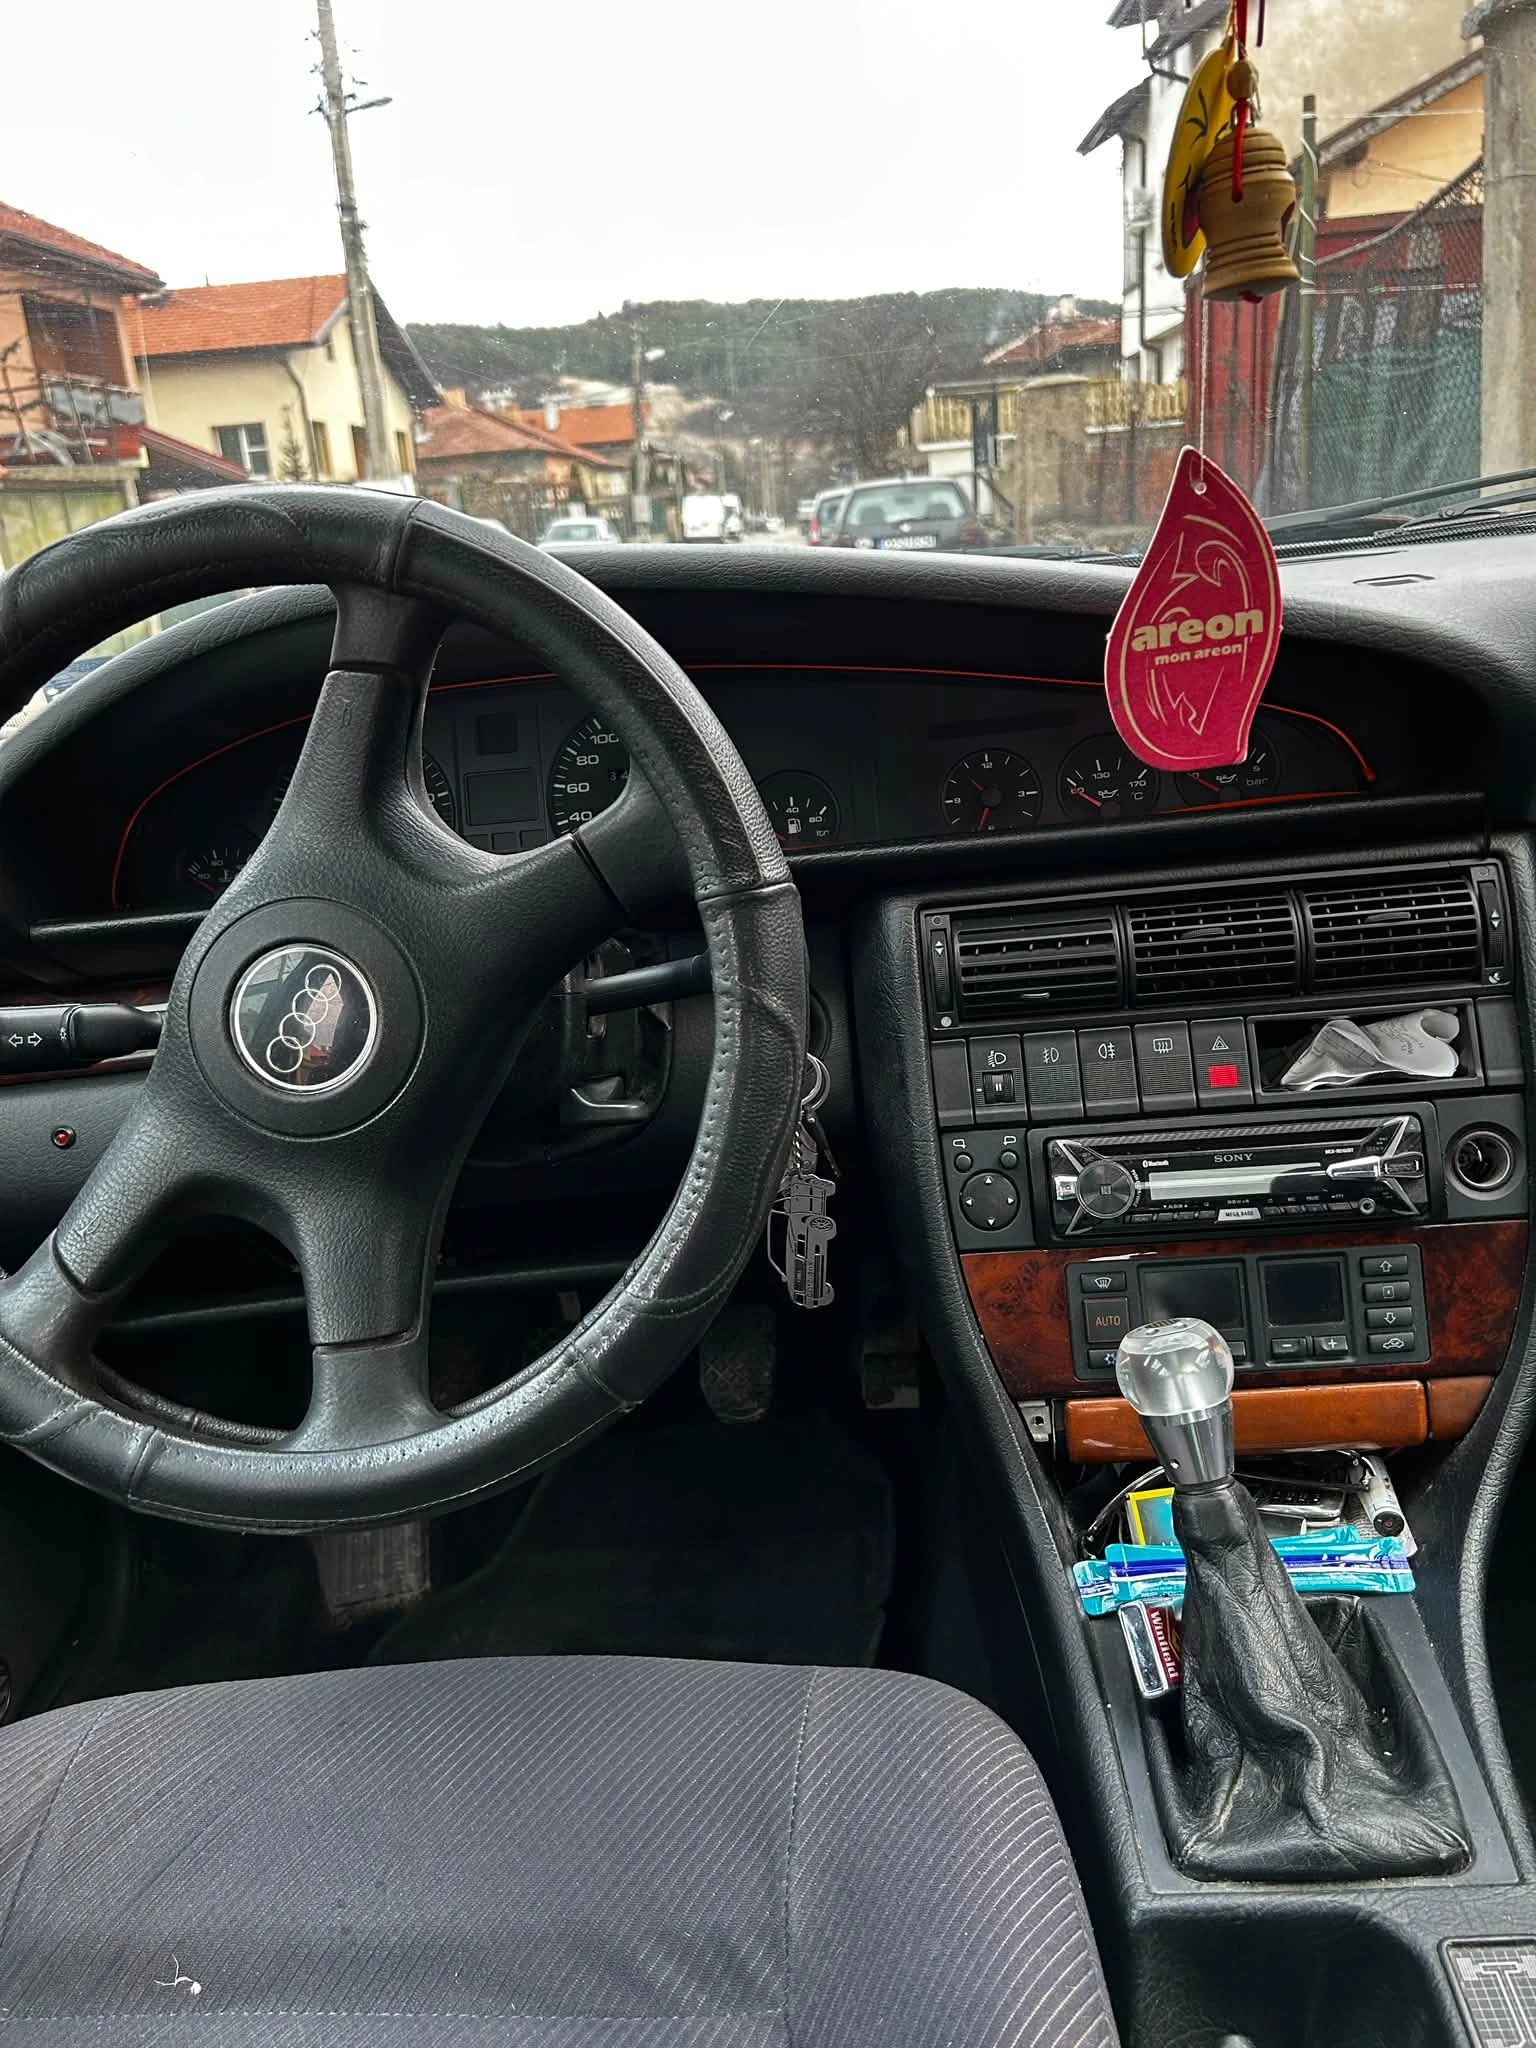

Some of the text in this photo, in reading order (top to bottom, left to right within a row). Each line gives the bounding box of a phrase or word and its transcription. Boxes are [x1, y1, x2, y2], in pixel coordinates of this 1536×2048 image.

[1131, 609, 1263, 652] areon
[1154, 643, 1243, 666] mon areon
[590, 733, 619, 744] 100
[576, 755, 599, 766] 80
[1092, 771, 1111, 780] 130
[567, 782, 590, 793] 60
[1129, 779, 1147, 788] 170
[569, 811, 593, 821] 40
[1213, 1152, 1254, 1164] SONY
[1095, 1315, 1121, 1327] AUTO
